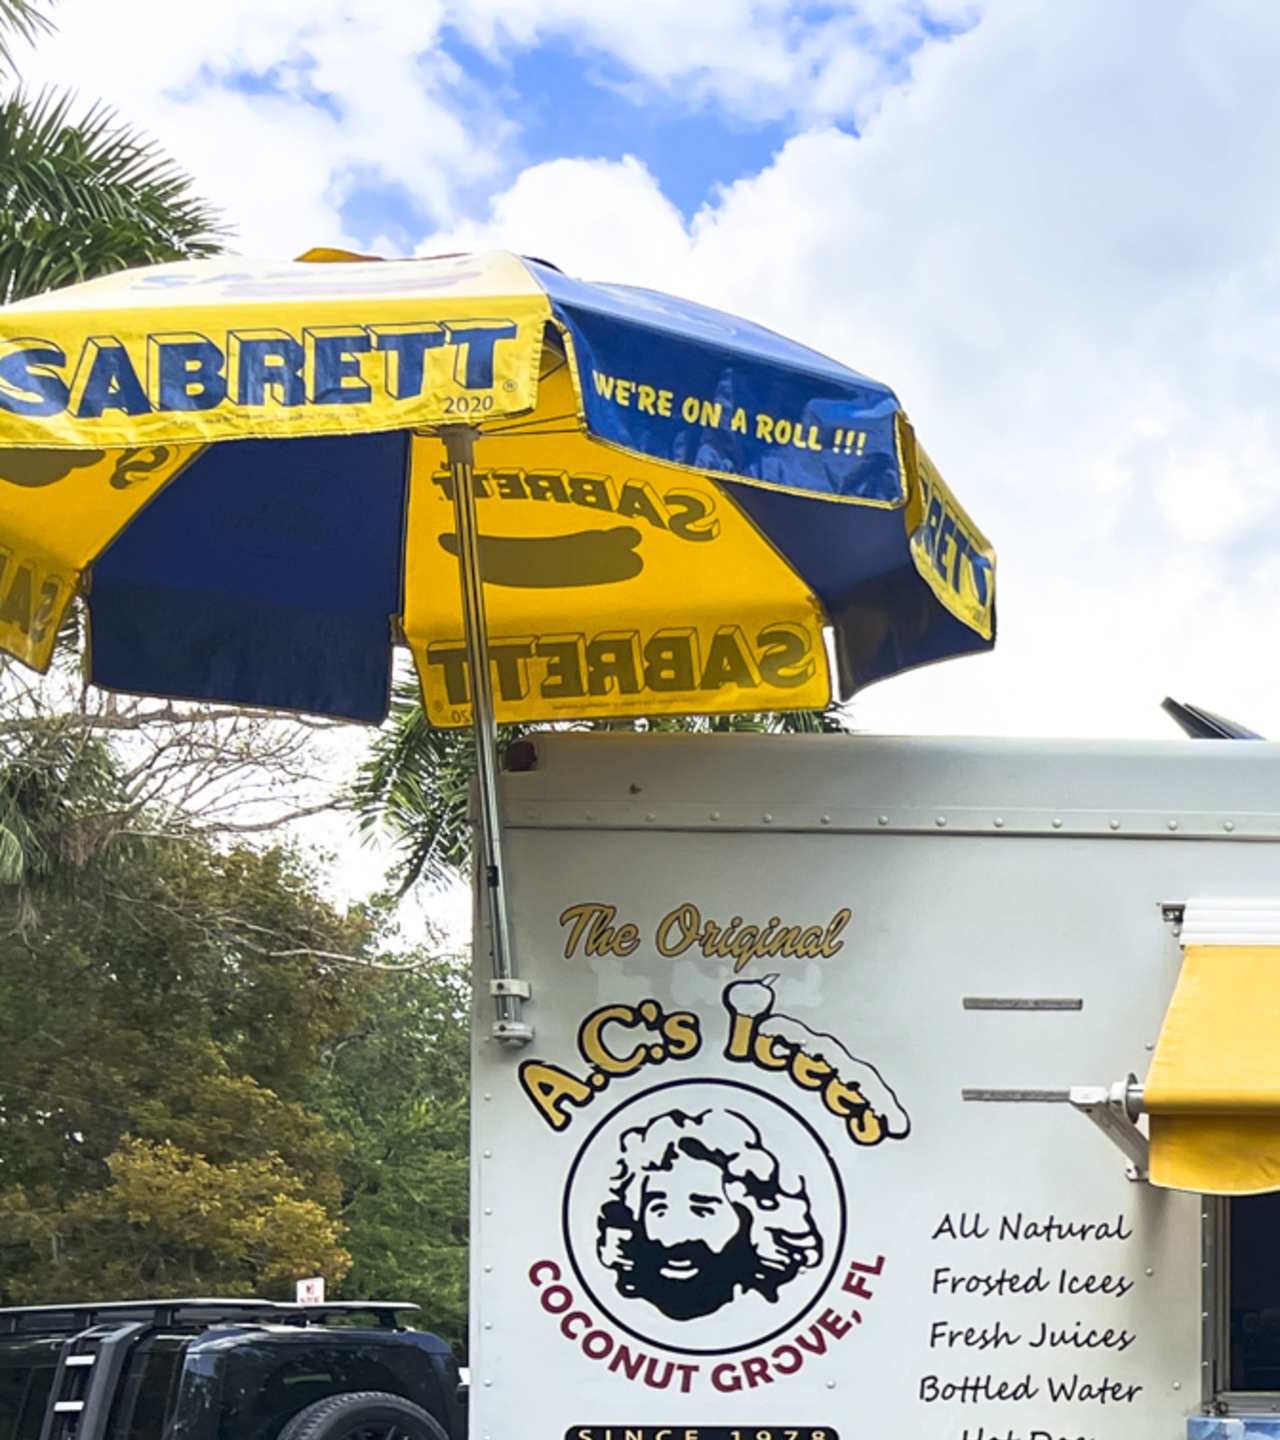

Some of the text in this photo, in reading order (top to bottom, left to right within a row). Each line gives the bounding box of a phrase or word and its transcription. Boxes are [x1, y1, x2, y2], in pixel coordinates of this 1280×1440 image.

[0, 319, 517, 418] SABRETT
[443, 396, 494, 414] 2020
[592, 369, 866, 456] WE'RE ON A ROLL !!!
[559, 903, 852, 973] The Original
[722, 974, 910, 1146] Icees
[931, 1213, 1132, 1241] All Natural
[932, 1266, 1133, 1298] Frosted Icees
[528, 1260, 698, 1394] COCONUT
[840, 1252, 886, 1302] FL
[929, 1321, 1136, 1351] Fresh Juices
[918, 1375, 1142, 1402] Bottled Water
